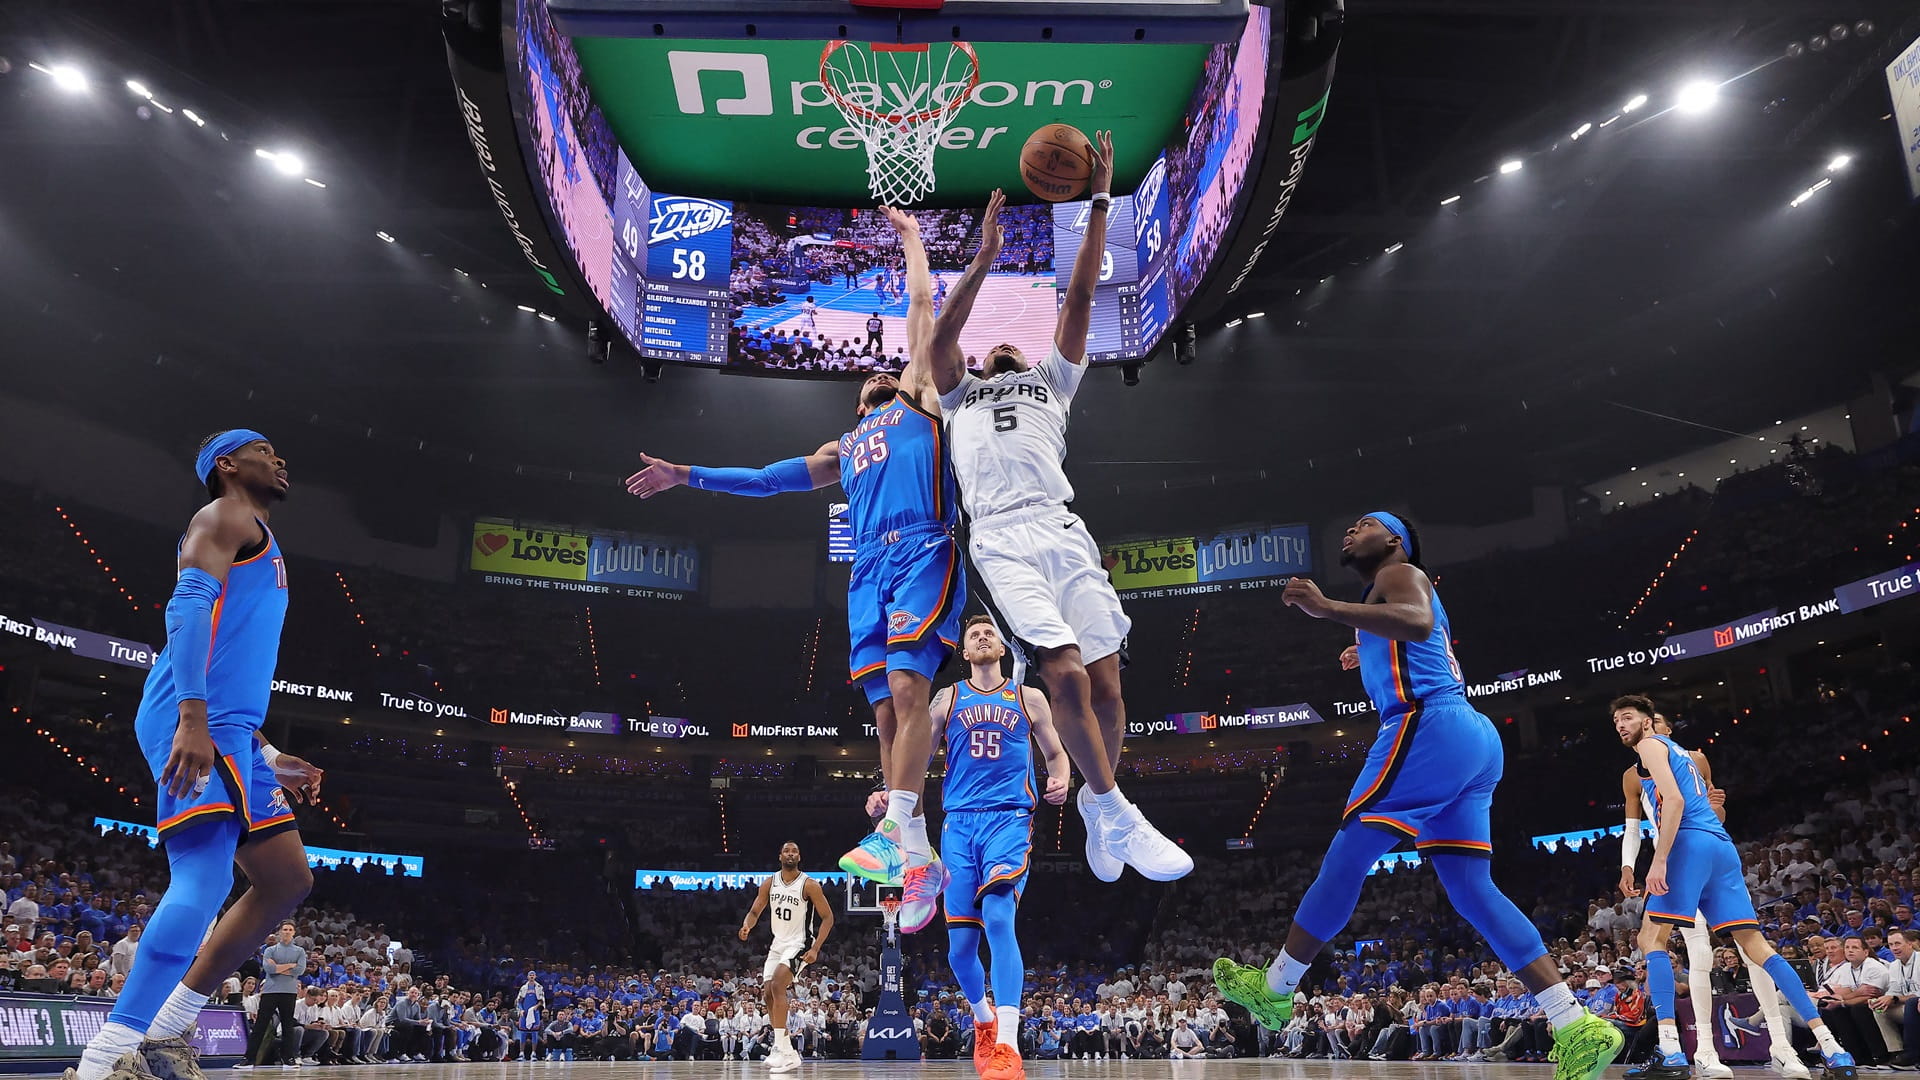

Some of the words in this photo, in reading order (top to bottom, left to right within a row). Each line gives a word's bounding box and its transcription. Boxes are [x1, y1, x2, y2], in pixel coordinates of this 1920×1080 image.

[460, 88, 496, 172] center
[1263, 137, 1313, 236] paycom
[488, 177, 547, 269] paycom
[622, 218, 638, 258] 49
[1147, 219, 1161, 263] 58
[672, 248, 706, 281] 58
[1100, 250, 1114, 281] 9
[645, 316, 676, 325] HOLMGREN
[645, 327, 672, 336] MITCHELL
[644, 338, 682, 347] HARTENSTEIN
[1106, 352, 1118, 360] 2ND
[965, 384, 1048, 409] SPURS
[993, 406, 1017, 432] 5
[841, 409, 904, 457] THUNDER
[853, 430, 890, 476] 25
[593, 545, 644, 576] LOUD
[652, 548, 696, 584] CITY
[1202, 536, 1254, 576] LOUD
[1261, 535, 1305, 567] CITY
[485, 575, 522, 586] BRING
[526, 579, 549, 589] THE
[553, 582, 609, 594] THUNDER
[627, 589, 653, 598] EXIT
[656, 592, 683, 601] NOW
[1119, 592, 1138, 600] ING
[1141, 589, 1164, 599] THE
[1166, 583, 1222, 596] THUNDER
[1240, 580, 1267, 590] EXIT
[1867, 573, 1913, 599] True
[108, 640, 147, 664] True
[1587, 656, 1625, 674] True
[1628, 651, 1646, 665] to
[1648, 644, 1686, 665] you.
[270, 680, 314, 697] DFIRST
[380, 692, 414, 711] True
[417, 699, 433, 713] to
[436, 702, 467, 719] you.
[957, 704, 1020, 732] THUNDER
[1334, 701, 1367, 715] True
[627, 718, 659, 734] True
[662, 721, 676, 736] to
[679, 724, 709, 740] you.
[862, 724, 879, 737] Tr
[1130, 720, 1144, 733] to
[1147, 721, 1177, 737] you.
[970, 730, 1002, 759] 55
[1687, 762, 1702, 796] 7
[306, 853, 342, 865] Oklahom
[717, 874, 737, 888] THE
[771, 893, 800, 906] SPURS
[775, 907, 792, 921] 40
[886, 966, 896, 974] GET
[887, 974, 896, 982] THE
[0, 1006, 39, 1046] GAME
[41, 1009, 54, 1046] 3
[207, 1025, 239, 1042] peacock
